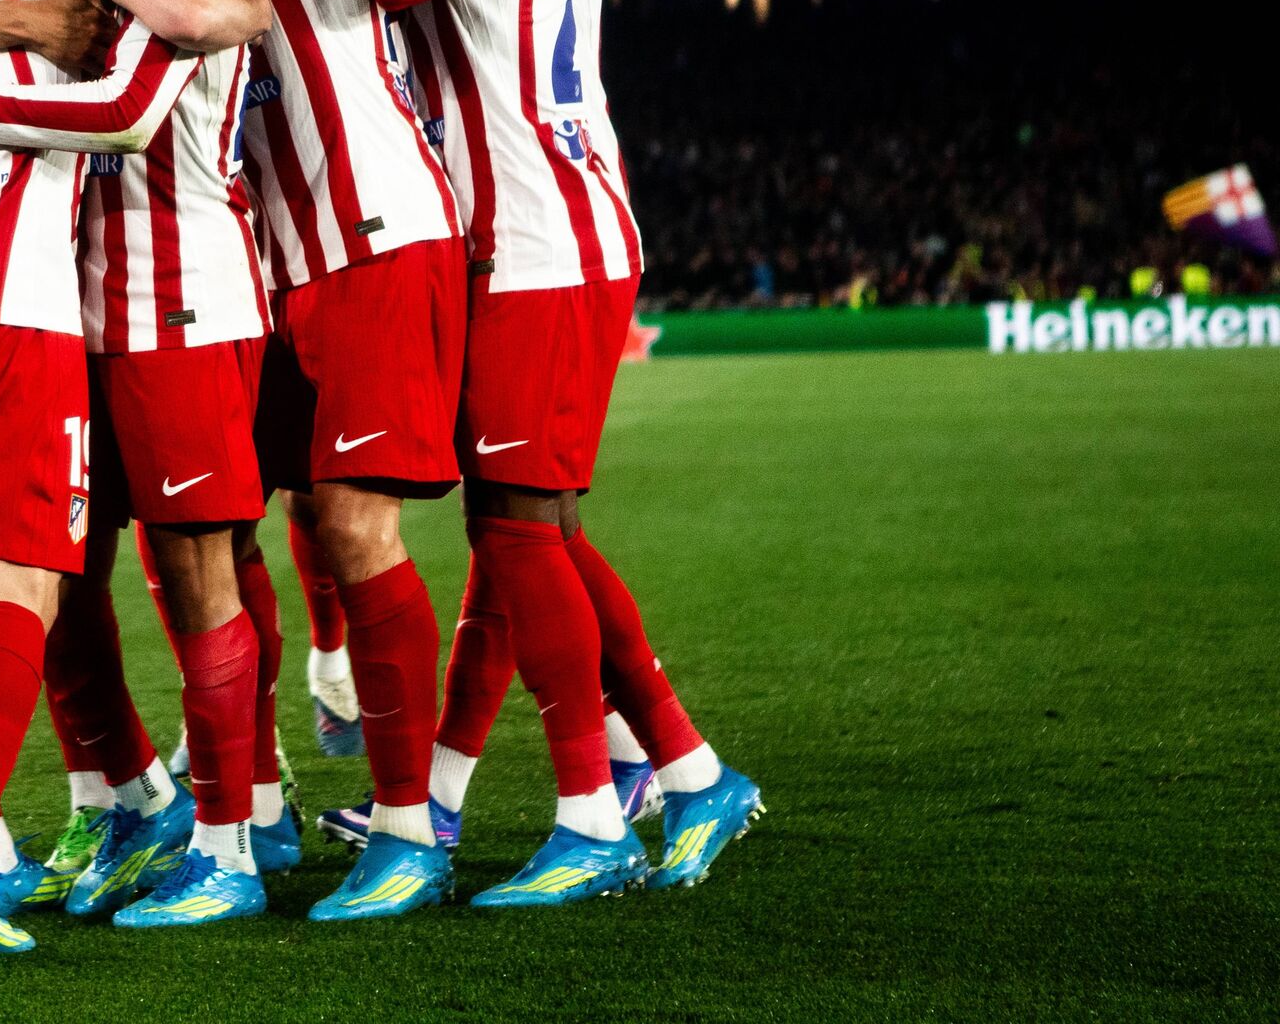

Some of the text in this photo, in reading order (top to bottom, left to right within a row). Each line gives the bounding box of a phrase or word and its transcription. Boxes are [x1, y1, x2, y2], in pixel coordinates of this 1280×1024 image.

[247, 79, 279, 103] AIR
[91, 153, 120, 174] AIR
[985, 292, 1280, 354] Heineken
